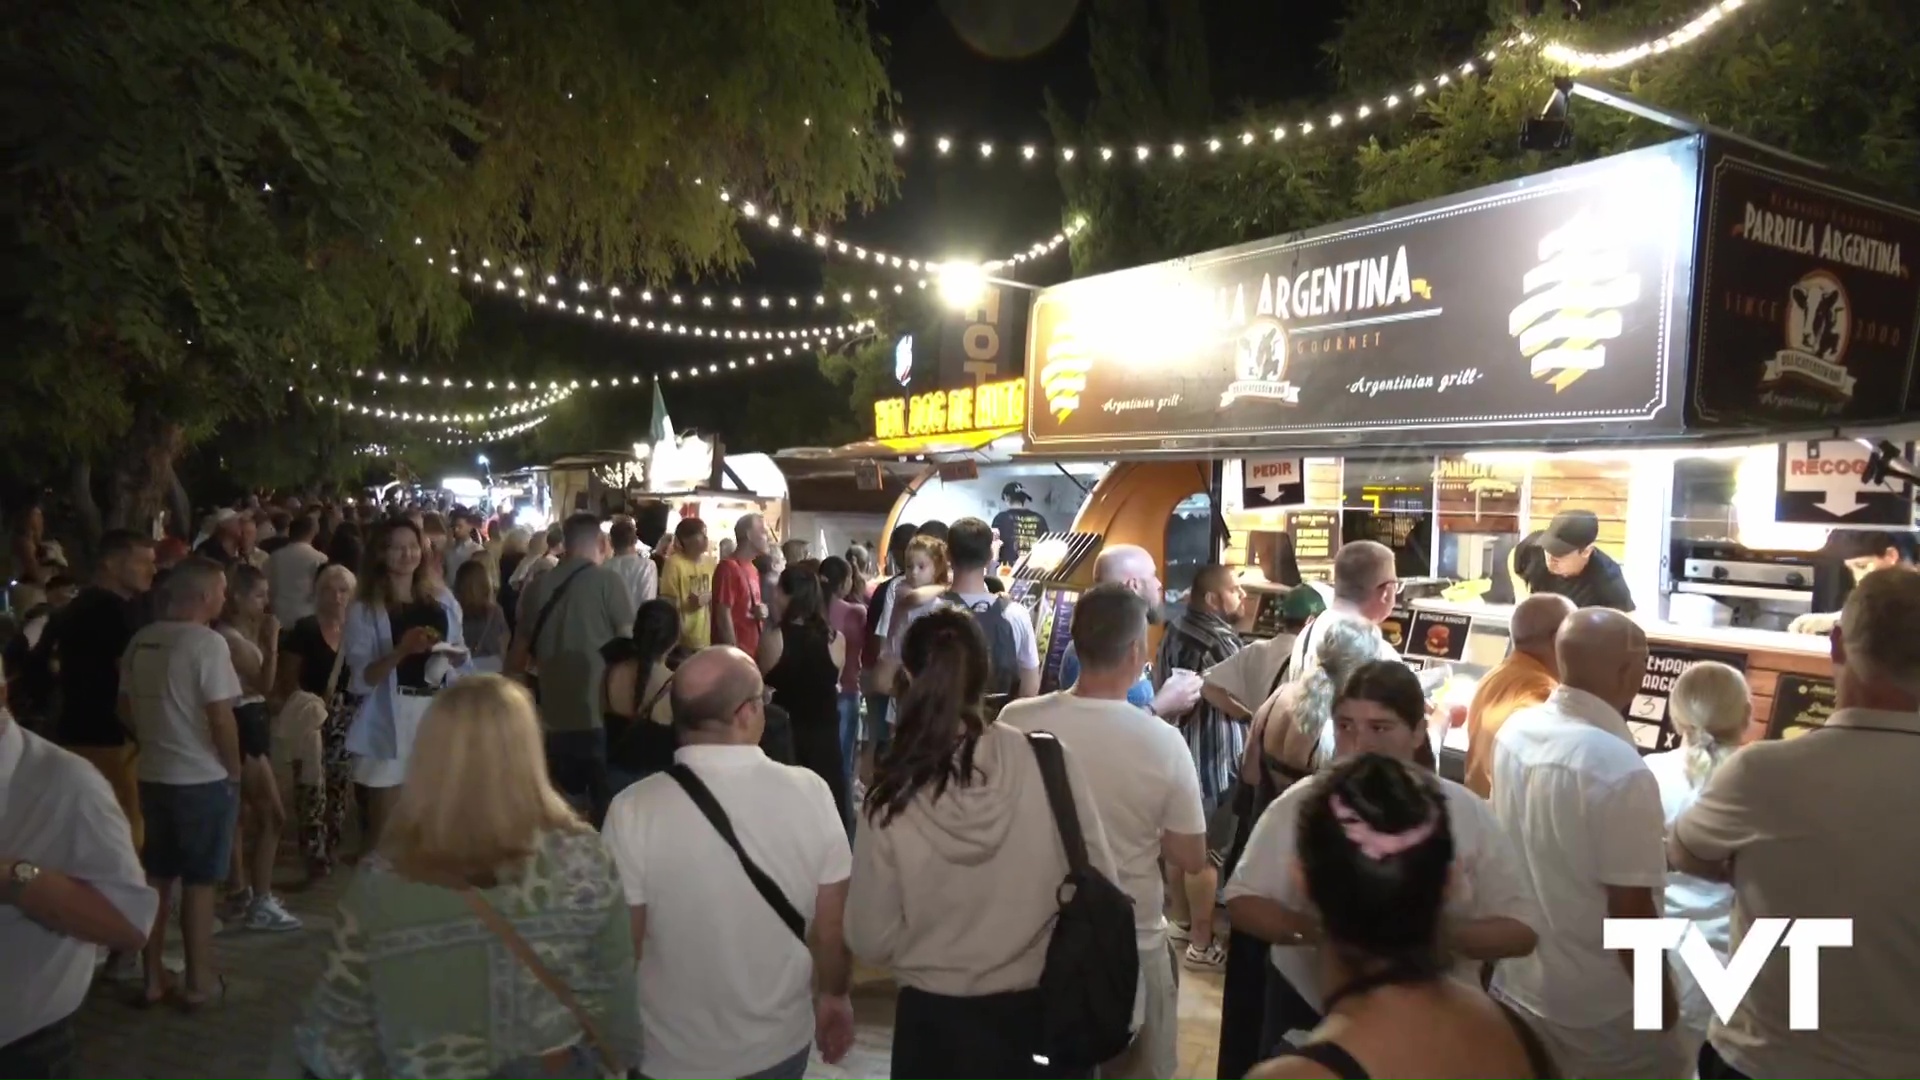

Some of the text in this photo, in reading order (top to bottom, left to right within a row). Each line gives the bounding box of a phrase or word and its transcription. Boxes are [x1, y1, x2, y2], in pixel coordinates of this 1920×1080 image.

[1742, 200, 1814, 255] PARRILLA
[1819, 223, 1901, 277] ARGENTINA
[1256, 245, 1412, 319] ARGENTINA
[1297, 332, 1381, 355] GOURMET
[1253, 462, 1292, 479] PEDIR
[1791, 459, 1867, 476] RECOG
[1639, 696, 1656, 716] 3
